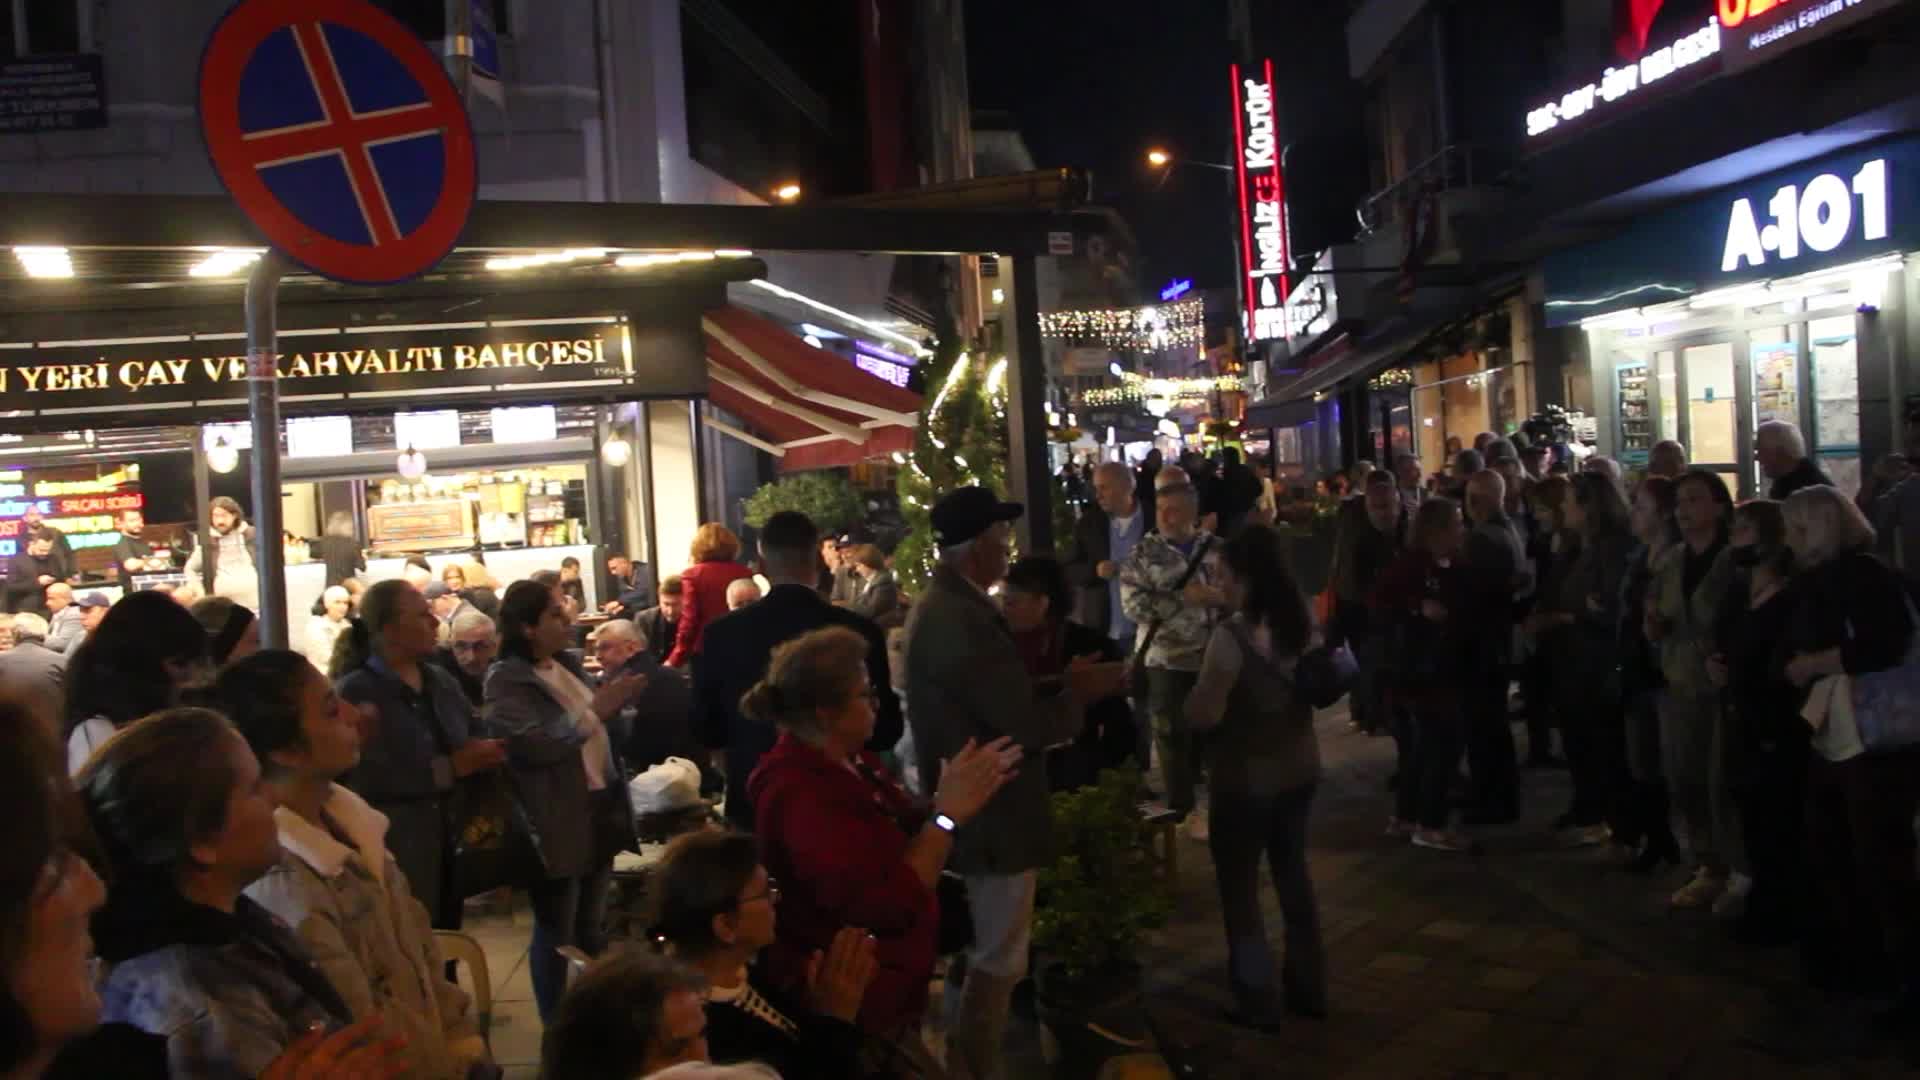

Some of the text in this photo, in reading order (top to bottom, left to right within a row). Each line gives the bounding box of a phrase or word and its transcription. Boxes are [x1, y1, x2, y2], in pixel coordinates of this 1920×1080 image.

[1798, 0, 1843, 28] Eğitim
[17, 356, 110, 392] YERİ
[118, 358, 192, 392] ÇAY
[454, 333, 607, 372] BAHÇESİ
